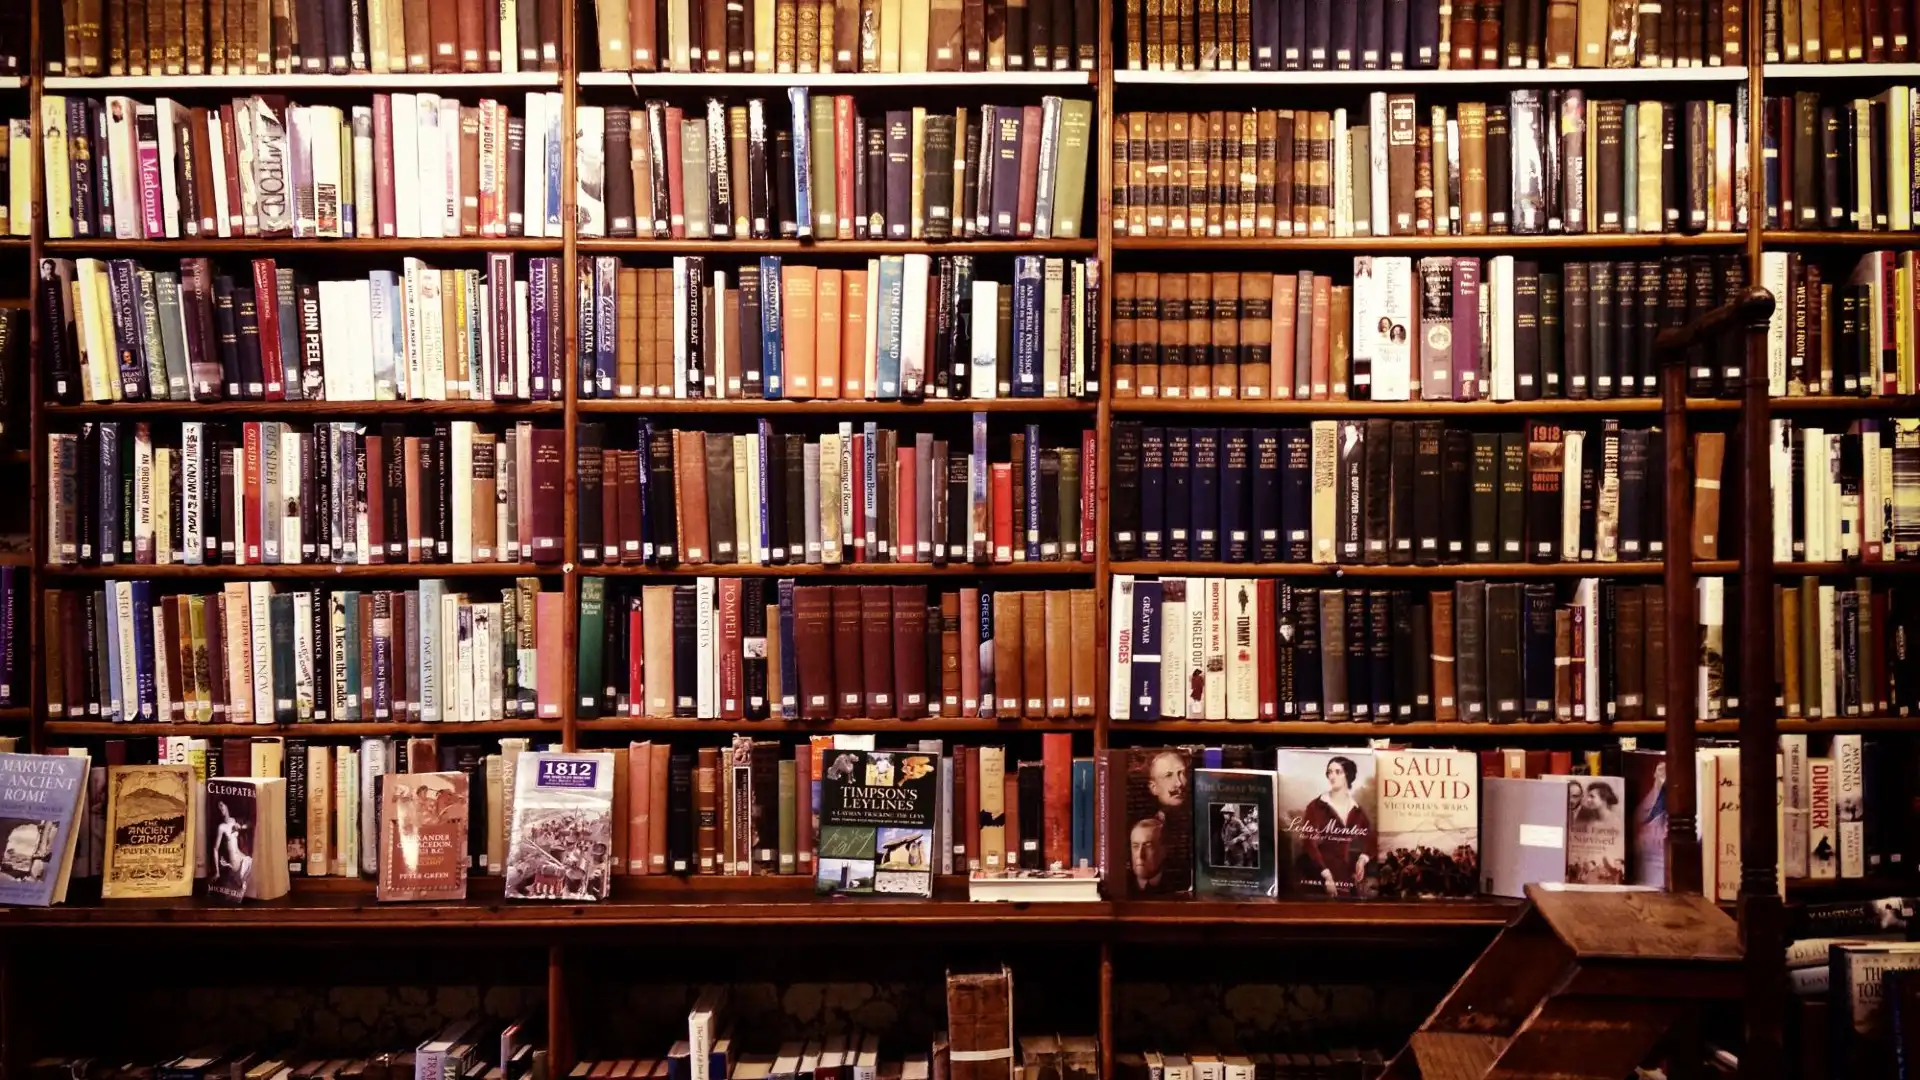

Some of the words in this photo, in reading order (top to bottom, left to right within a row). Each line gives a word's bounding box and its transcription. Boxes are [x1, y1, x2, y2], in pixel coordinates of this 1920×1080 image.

[717, 154, 728, 204] WHEELER
[142, 158, 159, 224] Madonna
[118, 268, 130, 305] PATRICK
[140, 272, 152, 298] Mary
[535, 267, 544, 312] TAMARA
[892, 281, 900, 304] TOM
[1026, 284, 1033, 297] AN
[690, 298, 698, 317] THE
[768, 266, 778, 333] MESOPOTAMIA
[1796, 286, 1806, 308] WEST
[123, 307, 134, 344] O'BRIAN
[144, 300, 156, 334] O'Hara
[304, 299, 318, 331] JOHN
[602, 296, 614, 352] CLEOPATRA
[1796, 310, 1806, 328] END
[584, 300, 593, 354] CLEOPATRA
[890, 308, 900, 359] HOLLAND
[306, 334, 320, 366] PEEL
[1025, 334, 1033, 375] POSSESSION
[1796, 330, 1806, 357] FRONT
[320, 428, 328, 445] JEAN
[842, 434, 852, 450] The
[866, 432, 874, 452] Later
[1533, 426, 1560, 441] 1918
[142, 454, 149, 464] AN
[248, 428, 257, 472] OUTSIDER
[266, 425, 278, 486] OUTSIDER
[358, 453, 366, 472] Nigel
[392, 436, 402, 488] SNOWDON
[840, 450, 852, 482] Coming
[866, 453, 875, 482] Roman
[142, 466, 150, 504] ORDINARY
[248, 476, 257, 485] II
[358, 472, 366, 492] Slater
[842, 483, 852, 492] of
[1350, 476, 1358, 492] DUFF
[1532, 483, 1559, 492] DALLAS
[842, 493, 852, 516] Rome
[866, 482, 876, 509] Britain
[1350, 492, 1358, 513] COOPER
[142, 508, 150, 524] MAN
[254, 595, 265, 633] PETER
[523, 584, 532, 621] TELLING
[724, 584, 736, 640] POMPEII
[1142, 596, 1150, 624] GREAT
[700, 584, 710, 648] AUGUSTUS
[982, 593, 990, 639] GREEKS
[523, 624, 532, 649] LIVES
[1142, 624, 1150, 644] WAR
[1192, 610, 1203, 649] SINGLED
[1212, 624, 1219, 632] IN
[1236, 616, 1250, 647] TOMMY
[242, 637, 248, 647] OF
[376, 638, 384, 665] HOUSE
[1118, 629, 1130, 664] VOICES
[1212, 634, 1220, 652] WAR
[336, 650, 344, 662] on
[424, 636, 432, 672] OSCAR
[1192, 650, 1203, 668] OUT
[255, 636, 268, 696] USTINOV
[336, 663, 346, 676] the
[377, 666, 384, 676] IN
[336, 679, 347, 708] Ladder
[1, 760, 66, 774] MARVELS
[289, 756, 297, 782] FAMILY
[296, 756, 304, 781] LOCAL
[544, 762, 592, 776] 1812
[1393, 756, 1459, 777] SAUL
[1842, 743, 1852, 792] CASSINO
[8, 775, 76, 790] ANCIENT
[207, 782, 256, 798] CLEOPATRA
[840, 786, 918, 800] TIMPSON'S
[1383, 779, 1470, 800] DAVID
[4, 789, 48, 803] ROME
[843, 798, 914, 810] LEYLINES
[1384, 802, 1439, 811] VICTORIA'S
[1443, 802, 1468, 812] WARS
[1812, 765, 1830, 830] DUNKIRK
[128, 826, 176, 834] ANCIENT
[1283, 816, 1314, 832] Lola
[1315, 818, 1368, 836] Montez
[130, 834, 170, 844] CAMPS
[424, 872, 449, 880] GREEN
[1794, 946, 1829, 959] BERL
